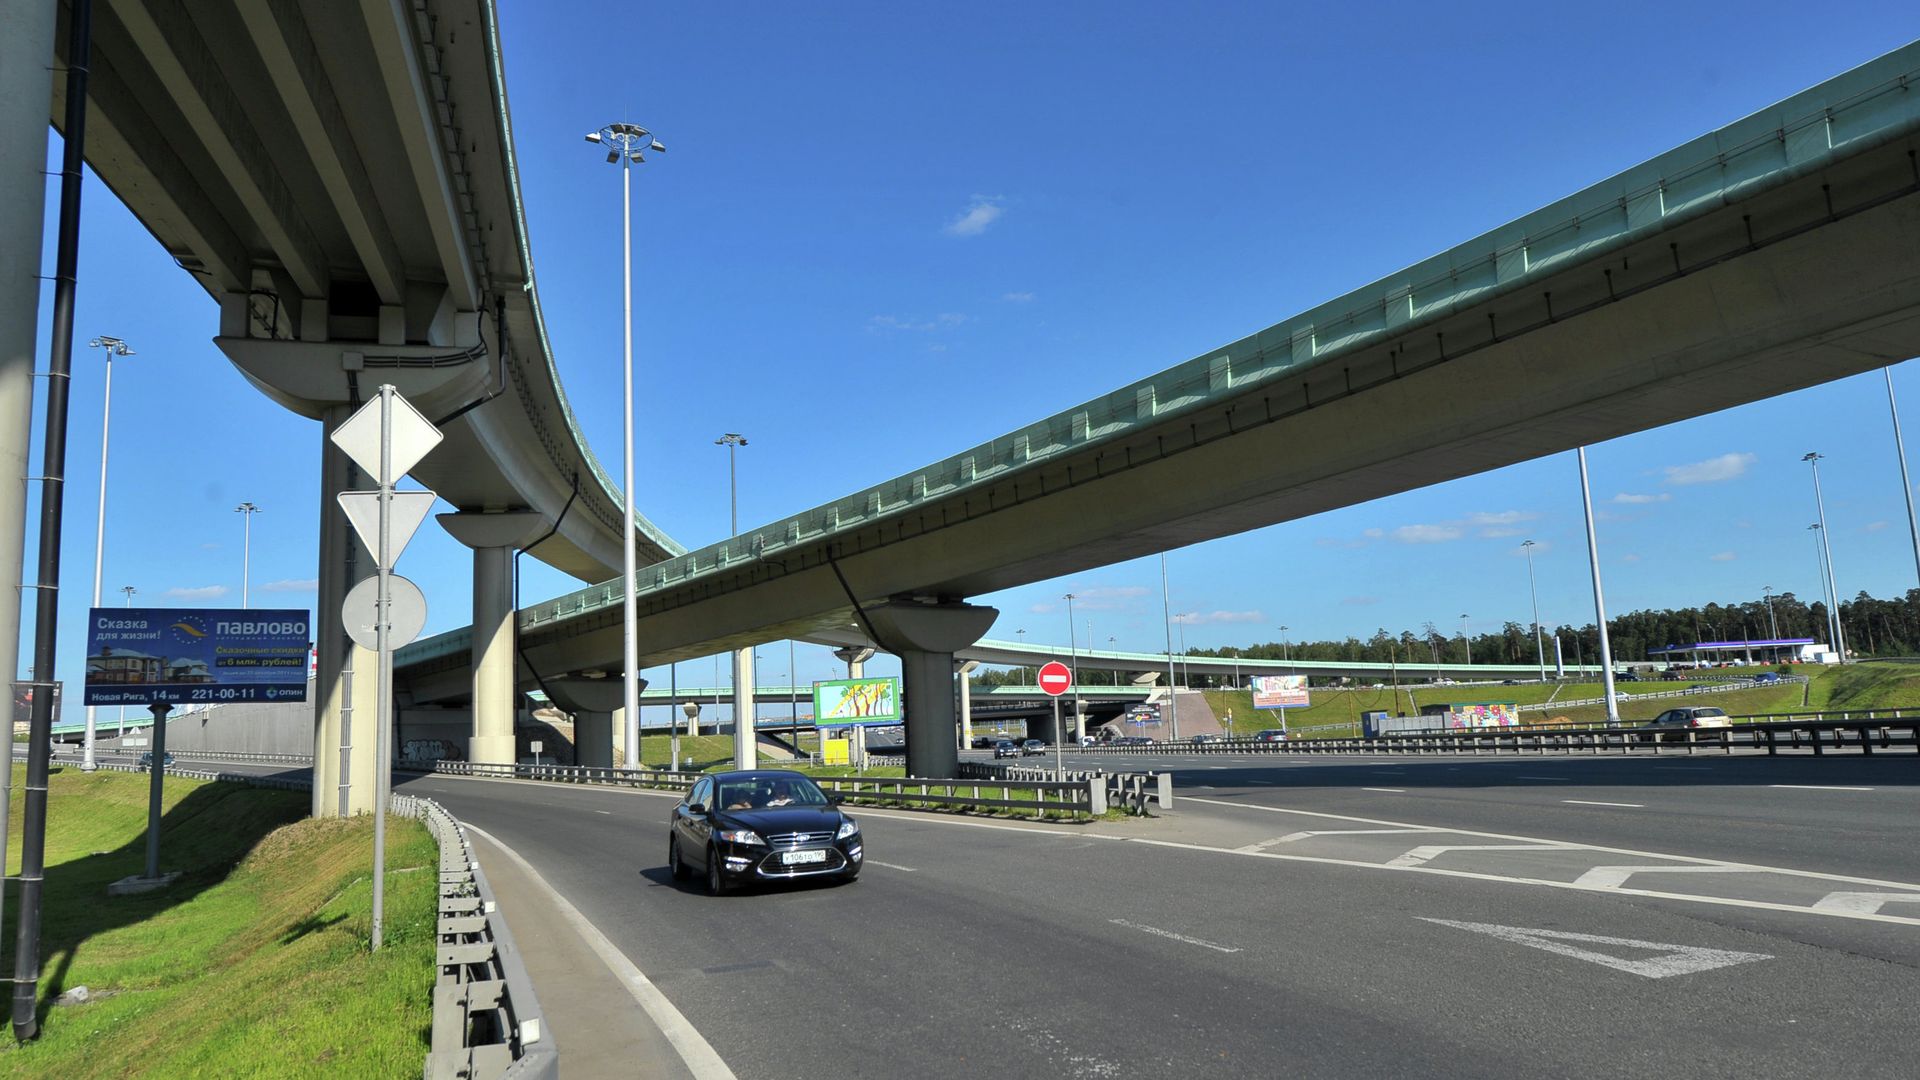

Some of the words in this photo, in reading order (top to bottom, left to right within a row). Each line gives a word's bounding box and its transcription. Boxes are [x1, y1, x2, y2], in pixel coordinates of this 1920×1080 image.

[97, 617, 148, 629] Сказка
[216, 622, 306, 635] павлово
[96, 632, 118, 640] для
[121, 630, 161, 640] жизни!
[262, 657, 302, 667] рублей!
[91, 693, 121, 701] Новая
[123, 692, 148, 701] Рига,
[152, 690, 167, 700] 14
[191, 688, 255, 699] 221-00-11
